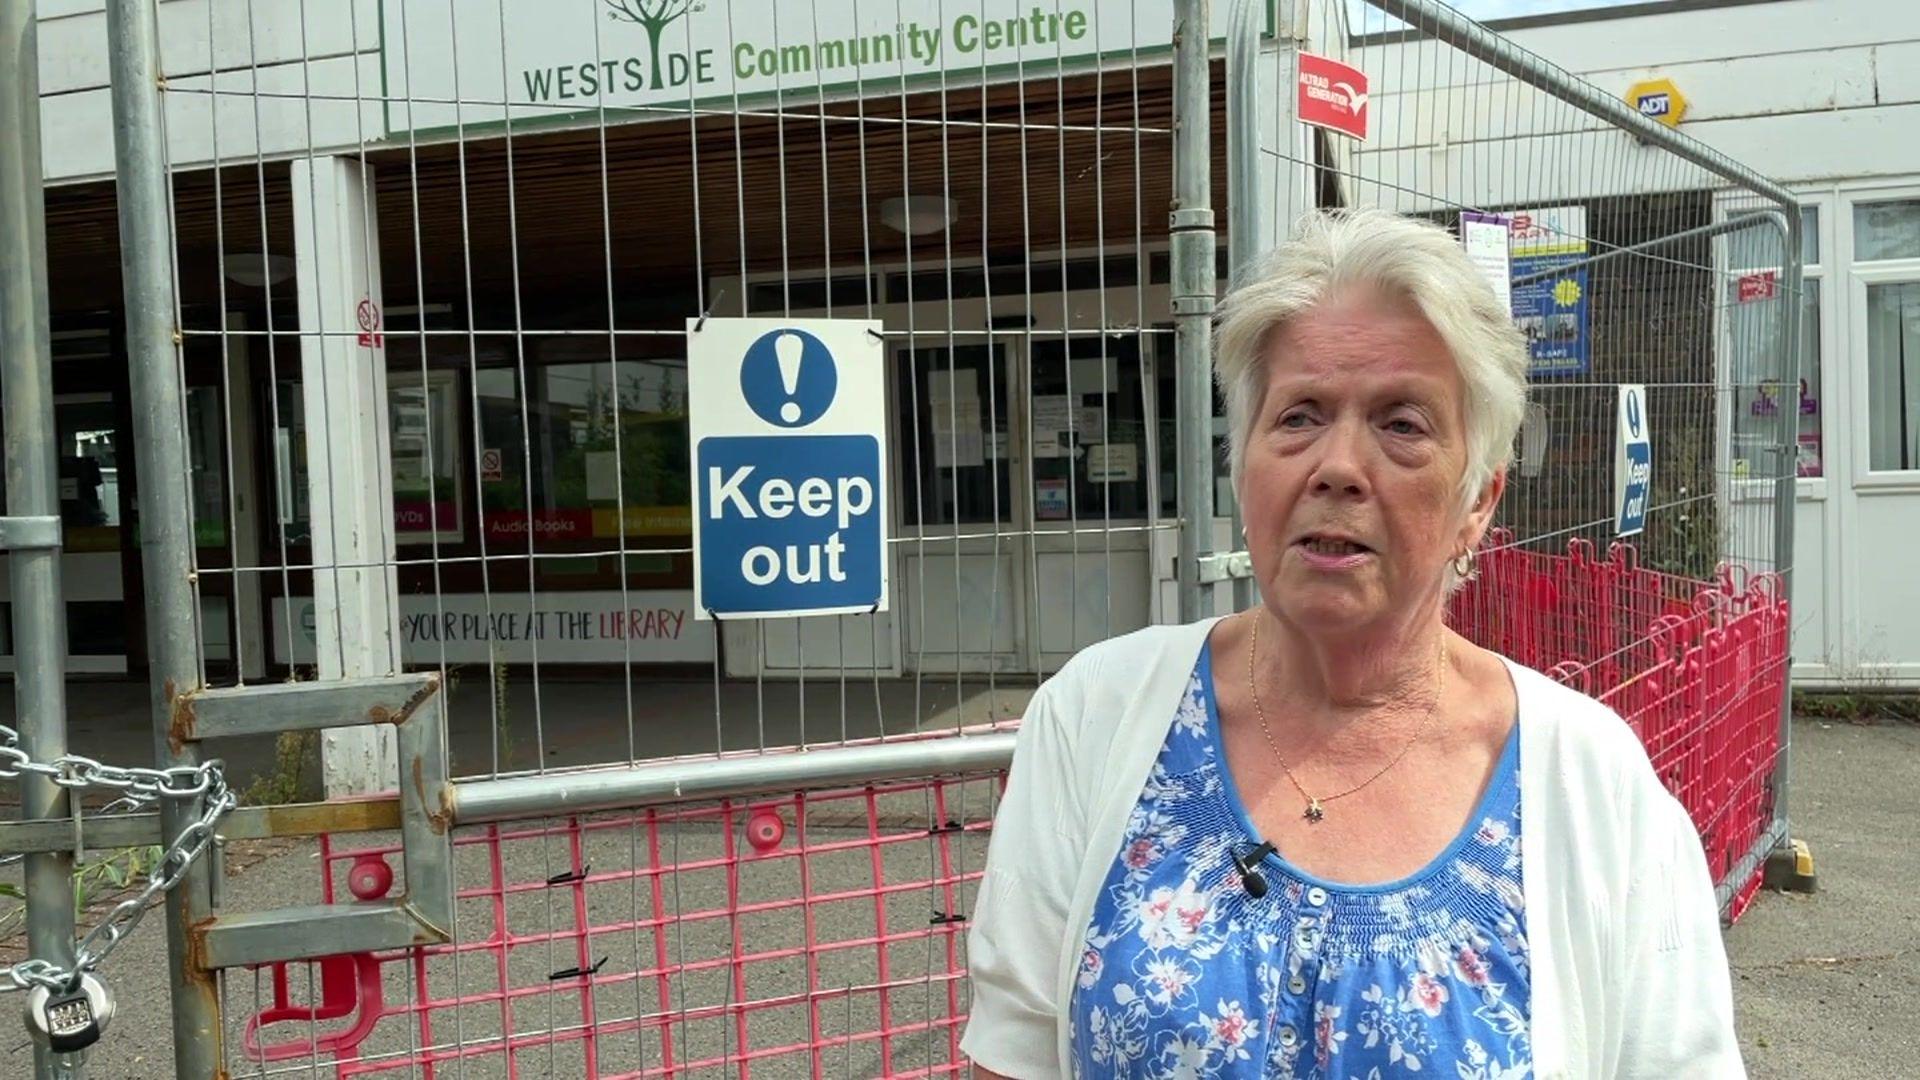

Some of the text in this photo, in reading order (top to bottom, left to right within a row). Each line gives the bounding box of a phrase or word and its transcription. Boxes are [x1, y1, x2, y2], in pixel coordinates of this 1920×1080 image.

[734, 22, 940, 80] Community
[953, 7, 1087, 53] Centre
[1640, 96, 1669, 113] ADT
[1627, 458, 1648, 490] Keep
[708, 466, 873, 529] Keep
[1627, 491, 1643, 519] out
[492, 519, 531, 533] Audio
[535, 518, 575, 532] Books
[741, 531, 847, 586] out
[407, 610, 456, 643] YOUR
[462, 611, 518, 641] PLACE
[524, 610, 548, 641] AT
[555, 609, 593, 640] THE
[600, 608, 685, 641] LIBRARY
